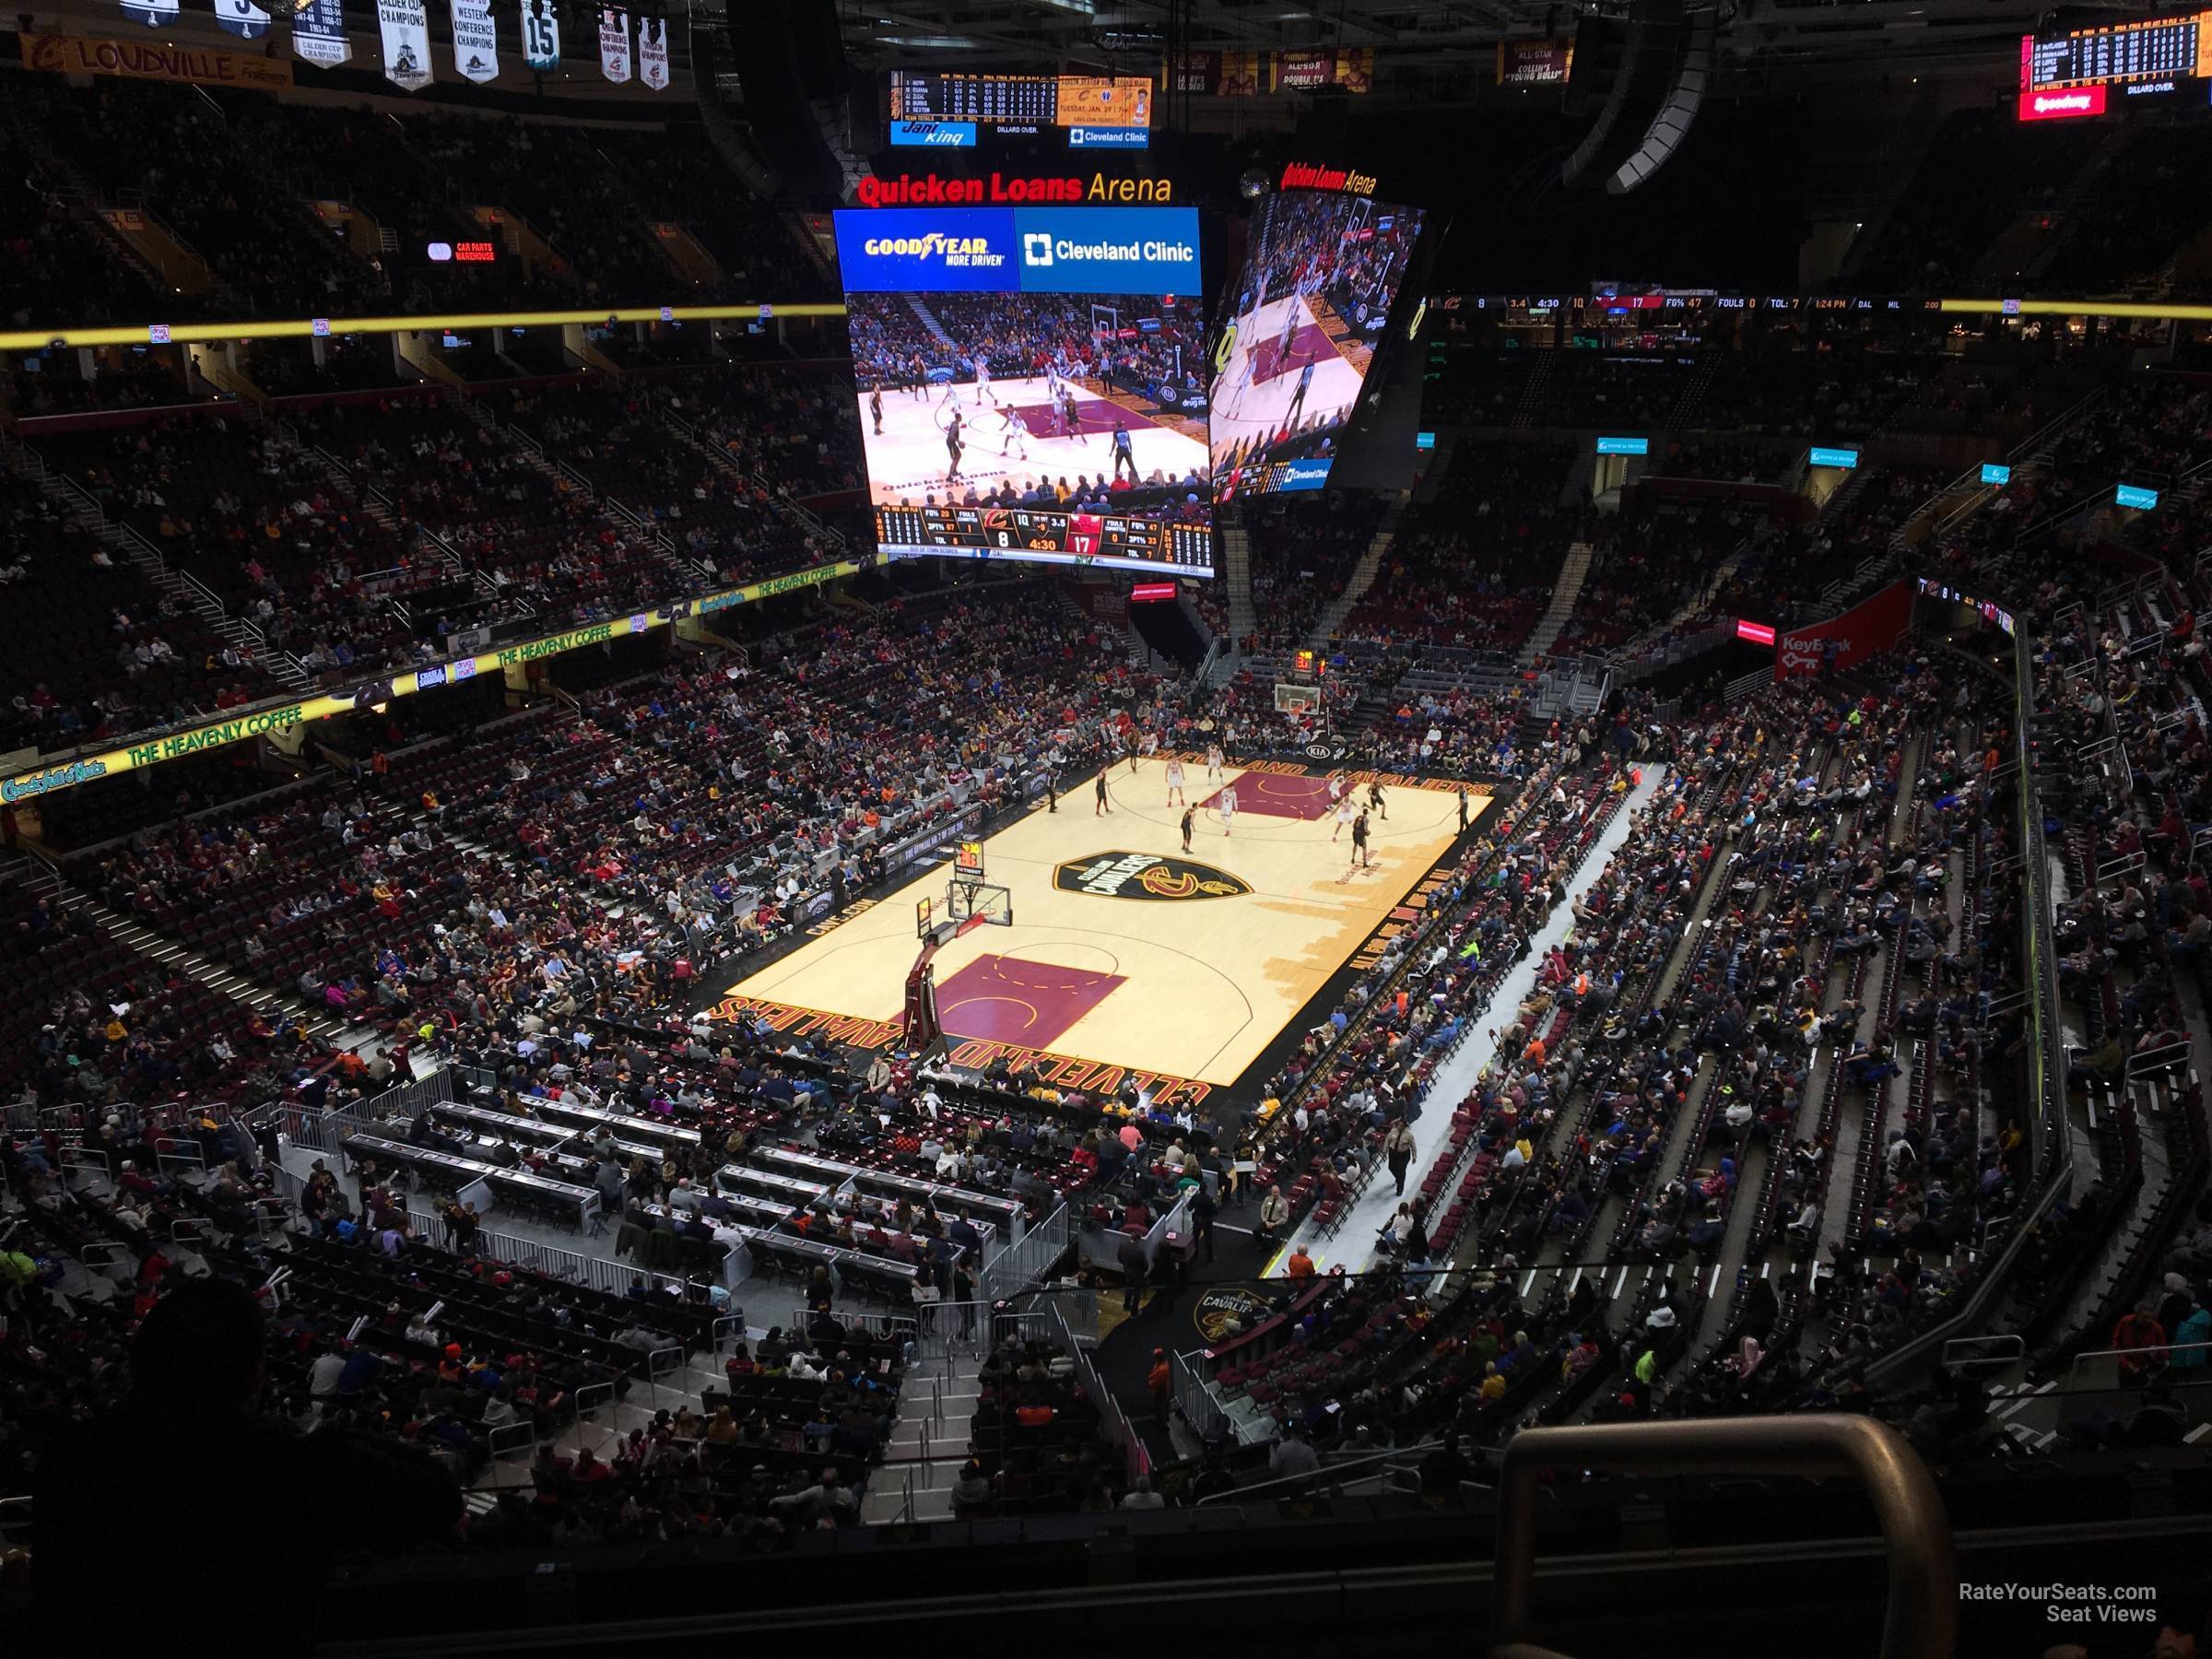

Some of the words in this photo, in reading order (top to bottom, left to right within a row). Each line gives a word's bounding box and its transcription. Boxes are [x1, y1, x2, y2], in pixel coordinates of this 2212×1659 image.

[380, 9, 425, 27] CHAMPIONS
[457, 6, 488, 21] WESTERN
[454, 21, 494, 36] CONFERENCE
[527, 17, 555, 55] 15
[302, 41, 327, 51] CALDER
[457, 35, 494, 50] CHAMPIONS
[303, 49, 342, 59] CHAMPIONS
[76, 41, 237, 81] LOUDVILLE
[1518, 64, 1551, 73] COLLIN'S
[2127, 85, 2154, 95] DILLARD
[2034, 95, 2091, 112] Speedway
[902, 121, 940, 134] Jani
[996, 125, 1020, 134] DILLARD
[1021, 126, 1039, 135] OVER.
[1085, 132, 1124, 141] Cleveland
[1124, 133, 1147, 142] Clinic
[1342, 169, 1377, 194] Arena
[858, 173, 983, 208] Quicken
[990, 172, 1083, 201] Loans
[1088, 172, 1172, 202] Arena
[456, 242, 471, 252] CAR
[471, 242, 493, 252] PARTS
[1055, 240, 1140, 261] Cleveland
[1143, 241, 1194, 262] Clinic
[455, 251, 495, 261] WAREHOUSE
[946, 254, 971, 266] MORE
[1477, 299, 1485, 309] 8
[1510, 299, 1526, 309] 3.4
[1537, 299, 1559, 309] 4:30
[1572, 299, 1584, 309] 1Q
[1632, 298, 1643, 309] 17
[1665, 298, 1685, 308] FG%
[1688, 298, 1701, 309] 47
[1718, 299, 1744, 309] FOULS
[1748, 299, 1756, 309] 0
[1770, 299, 1789, 309] TOL:
[1793, 299, 1799, 309] 7
[1815, 300, 1832, 309] 1:24
[1833, 300, 1846, 309] PM
[1858, 300, 1873, 309] DAL
[1888, 300, 1900, 309] MIL
[1924, 300, 1939, 309] 2:00
[1163, 389, 1175, 398] KIA
[1182, 398, 1198, 408] drug
[925, 510, 939, 518] FG%
[1018, 514, 1030, 527] 1Q
[1051, 518, 1066, 527] 3.5
[1106, 520, 1124, 528] FOULS
[928, 523, 945, 532] 3PT%
[1131, 522, 1146, 531] FG%
[1148, 524, 1158, 532] 47
[935, 536, 947, 545] TOL
[998, 531, 1009, 547] 8
[1074, 535, 1089, 553] 17
[1112, 534, 1118, 543] 0
[1128, 535, 1147, 545] 3PT%
[1147, 536, 1157, 545] 33
[1029, 538, 1056, 551] 4:30
[1127, 549, 1139, 559] TOL
[1147, 550, 1152, 559] 7
[759, 582, 772, 597] THE
[772, 571, 810, 594] HEAVENLY
[810, 565, 837, 583] COFFEE
[497, 650, 518, 666] THE
[520, 635, 573, 661] HEAVENLY
[575, 625, 612, 645] COFFEE
[456, 659, 472, 670] drug
[128, 745, 160, 768] THE
[163, 721, 243, 759] HEAVENLY
[246, 705, 303, 735] COFFEE
[1310, 747, 1327, 756] KIA
[1082, 854, 1164, 896] CAVALIERS
